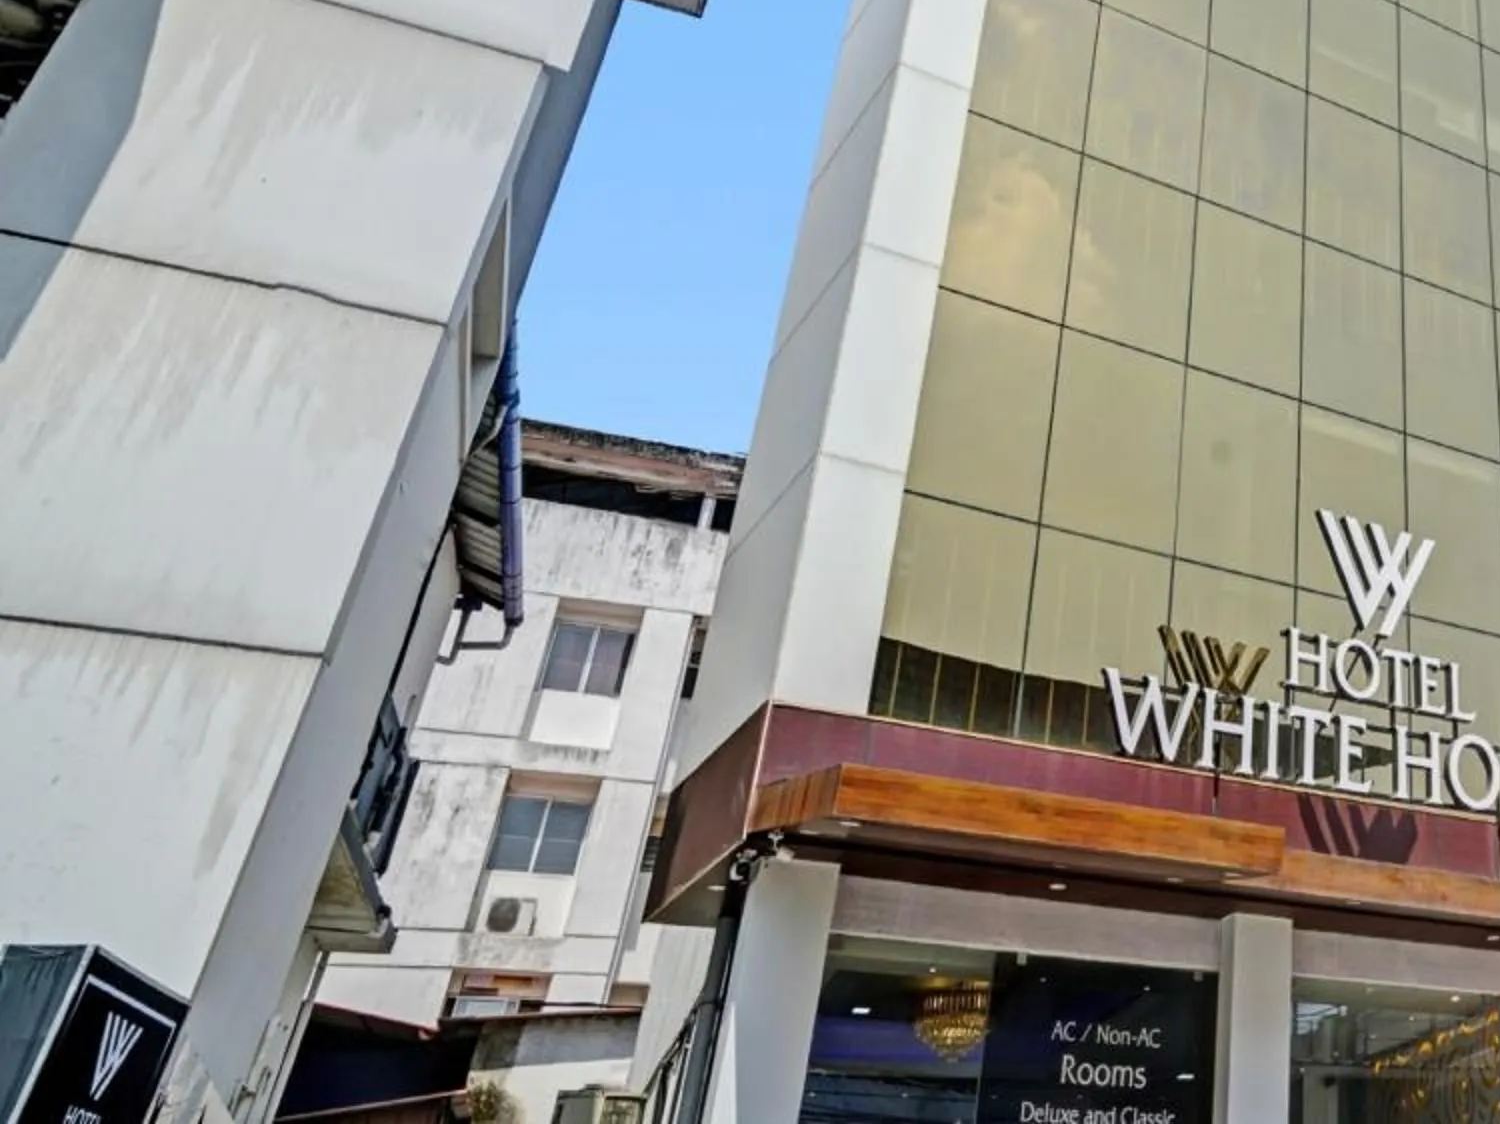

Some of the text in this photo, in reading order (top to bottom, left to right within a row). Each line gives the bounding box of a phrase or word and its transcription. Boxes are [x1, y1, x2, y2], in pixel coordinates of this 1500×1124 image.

[1286, 627, 1476, 722] HOTEL
[1102, 667, 1374, 792] WHITE
[1051, 1020, 1076, 1042] AC
[1096, 1025, 1161, 1048] Non-AC
[1060, 1053, 1147, 1089] Rooms
[1020, 1100, 1080, 1124] Deluxe
[1083, 1106, 1116, 1124] and
